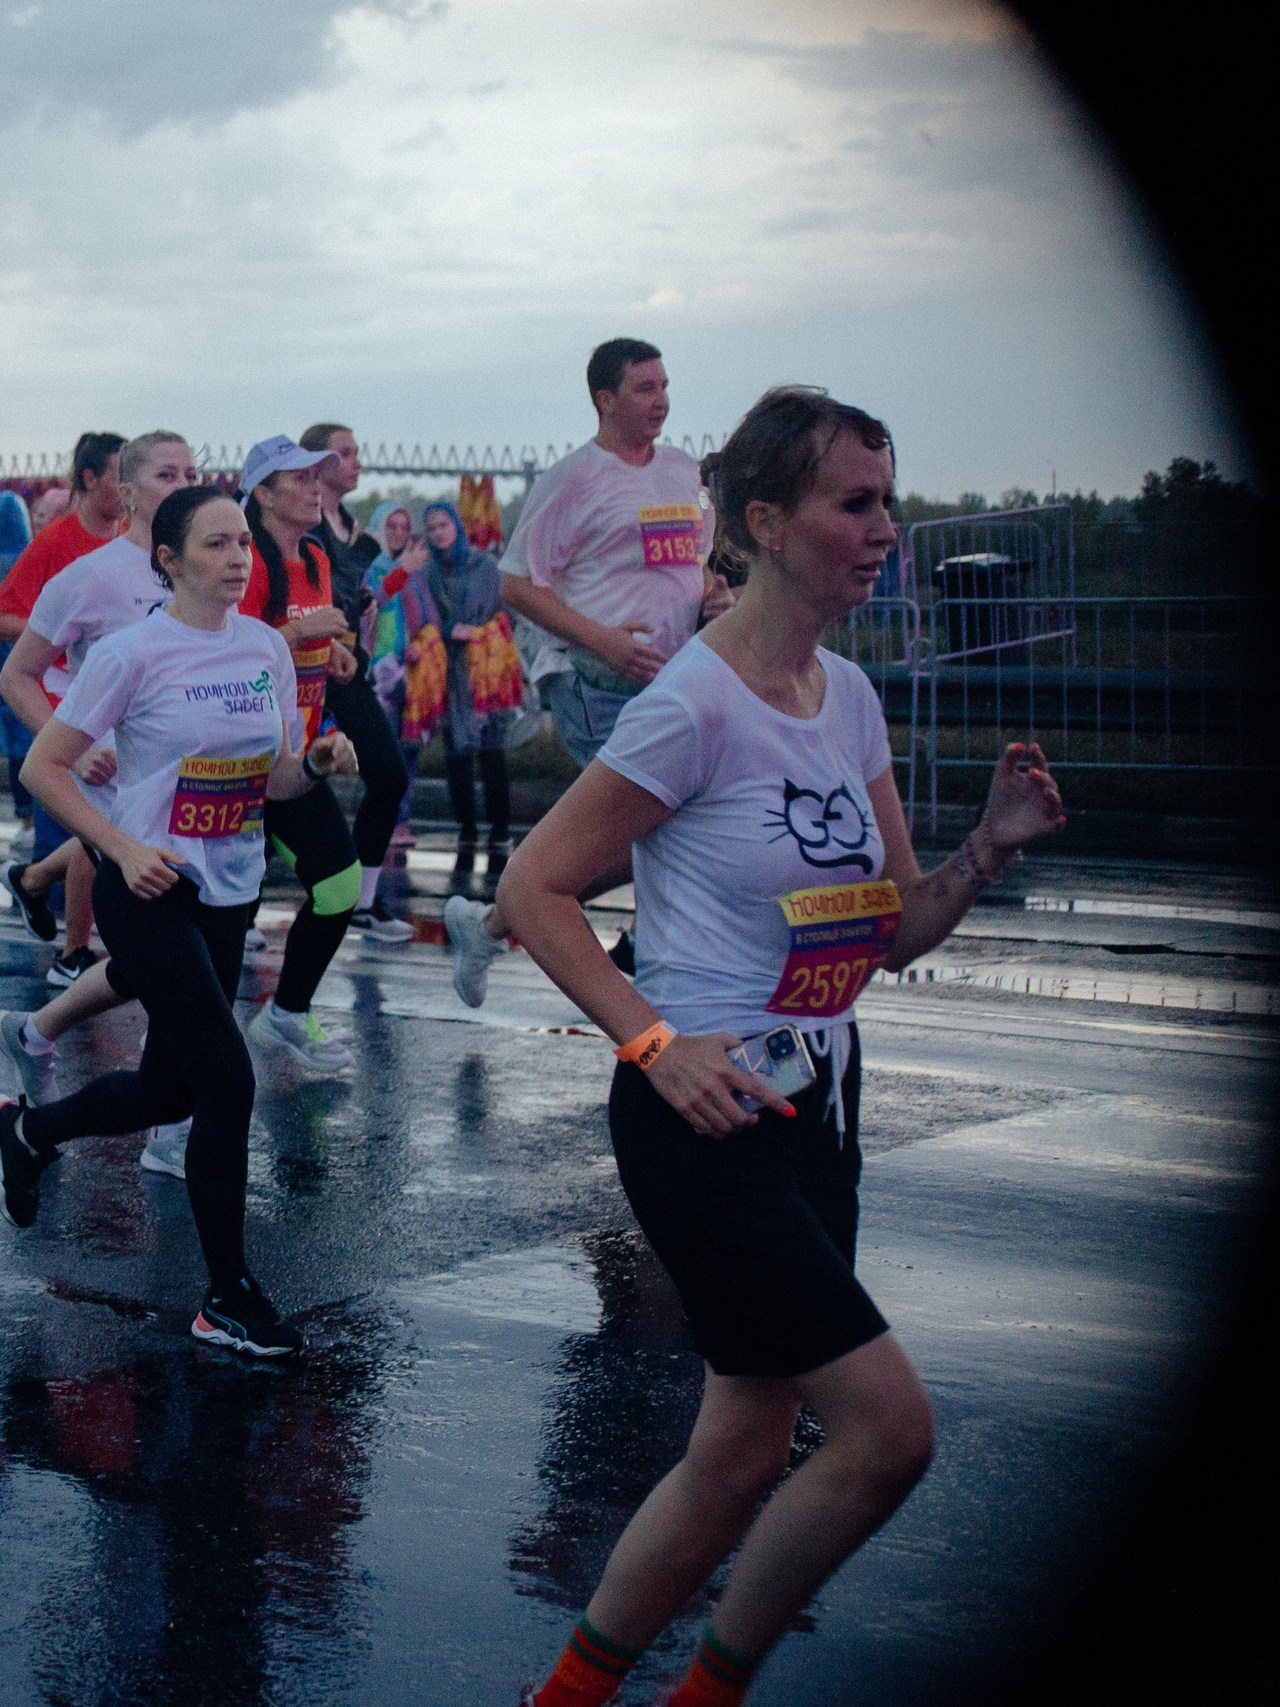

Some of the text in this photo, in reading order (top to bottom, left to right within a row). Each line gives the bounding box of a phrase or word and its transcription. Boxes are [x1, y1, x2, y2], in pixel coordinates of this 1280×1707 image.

[649, 536, 695, 562] 3153
[177, 801, 244, 833] 3312
[779, 958, 869, 1009] 2597
